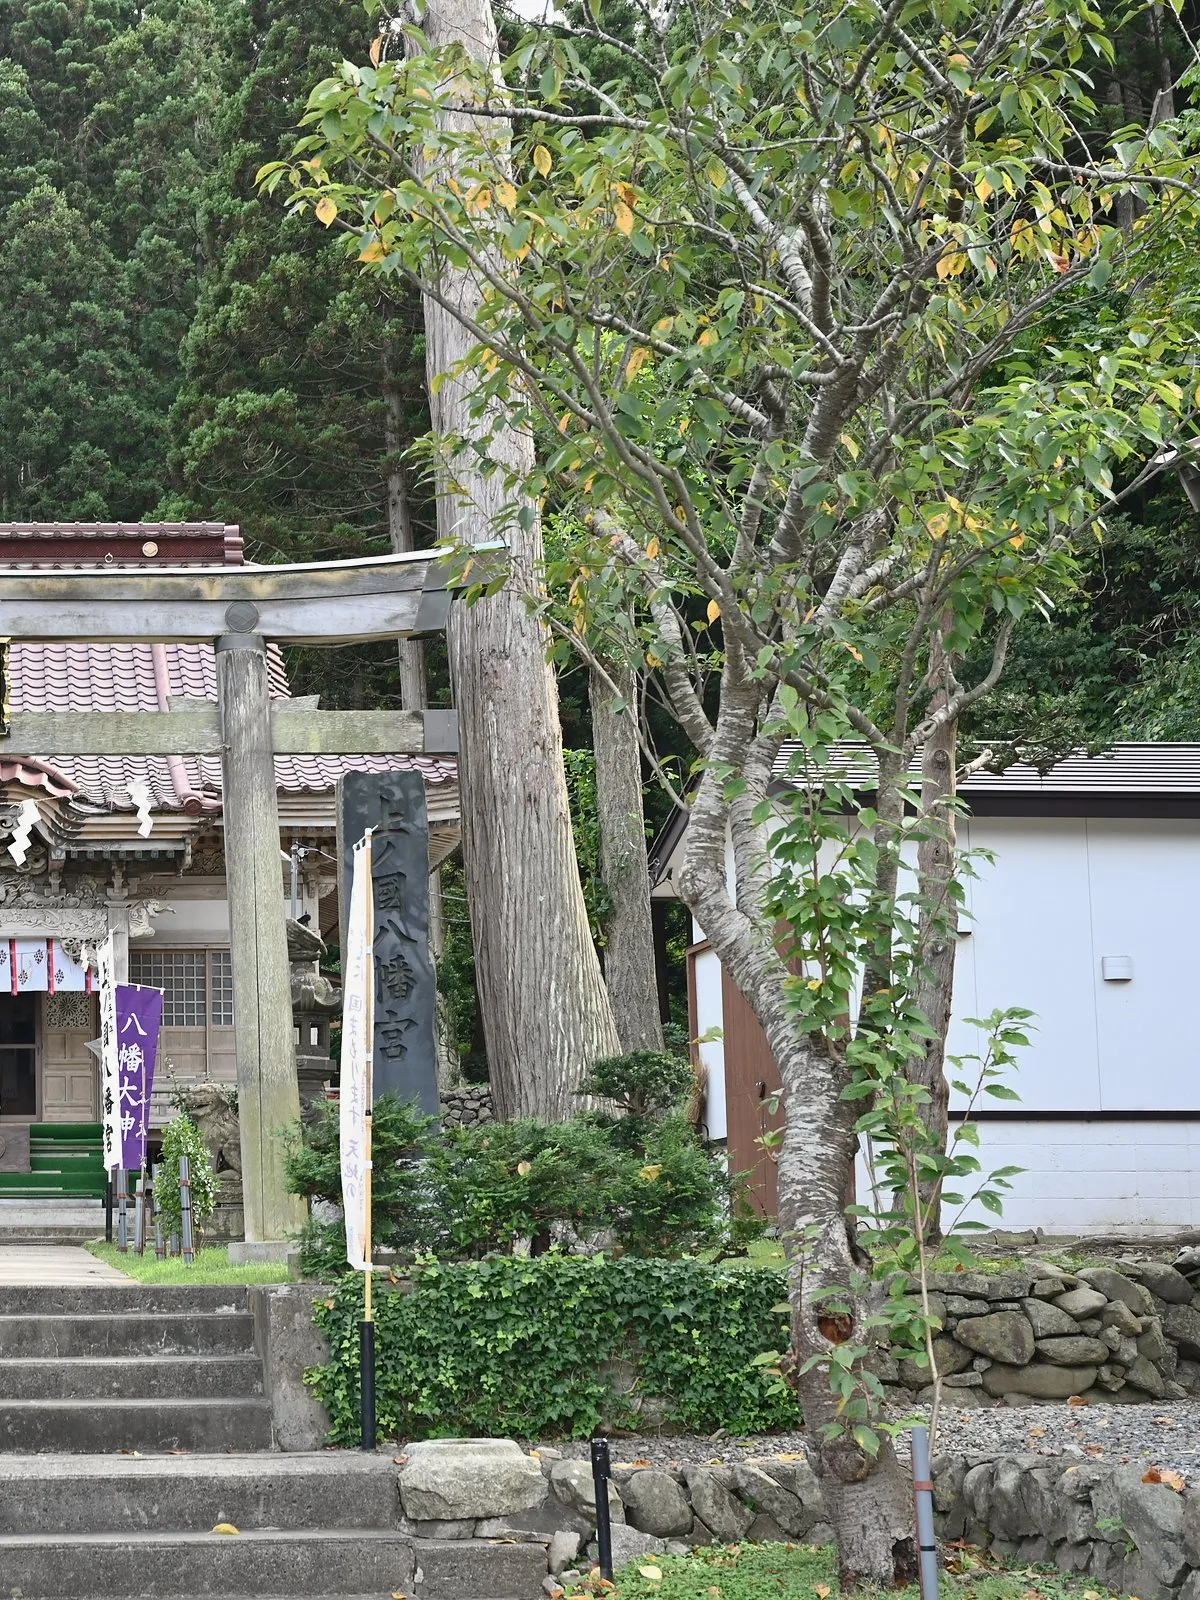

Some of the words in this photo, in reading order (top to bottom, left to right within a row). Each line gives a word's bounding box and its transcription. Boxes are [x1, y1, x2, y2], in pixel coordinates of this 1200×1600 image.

[371, 794, 419, 1064] 上ノ國八幡宮
